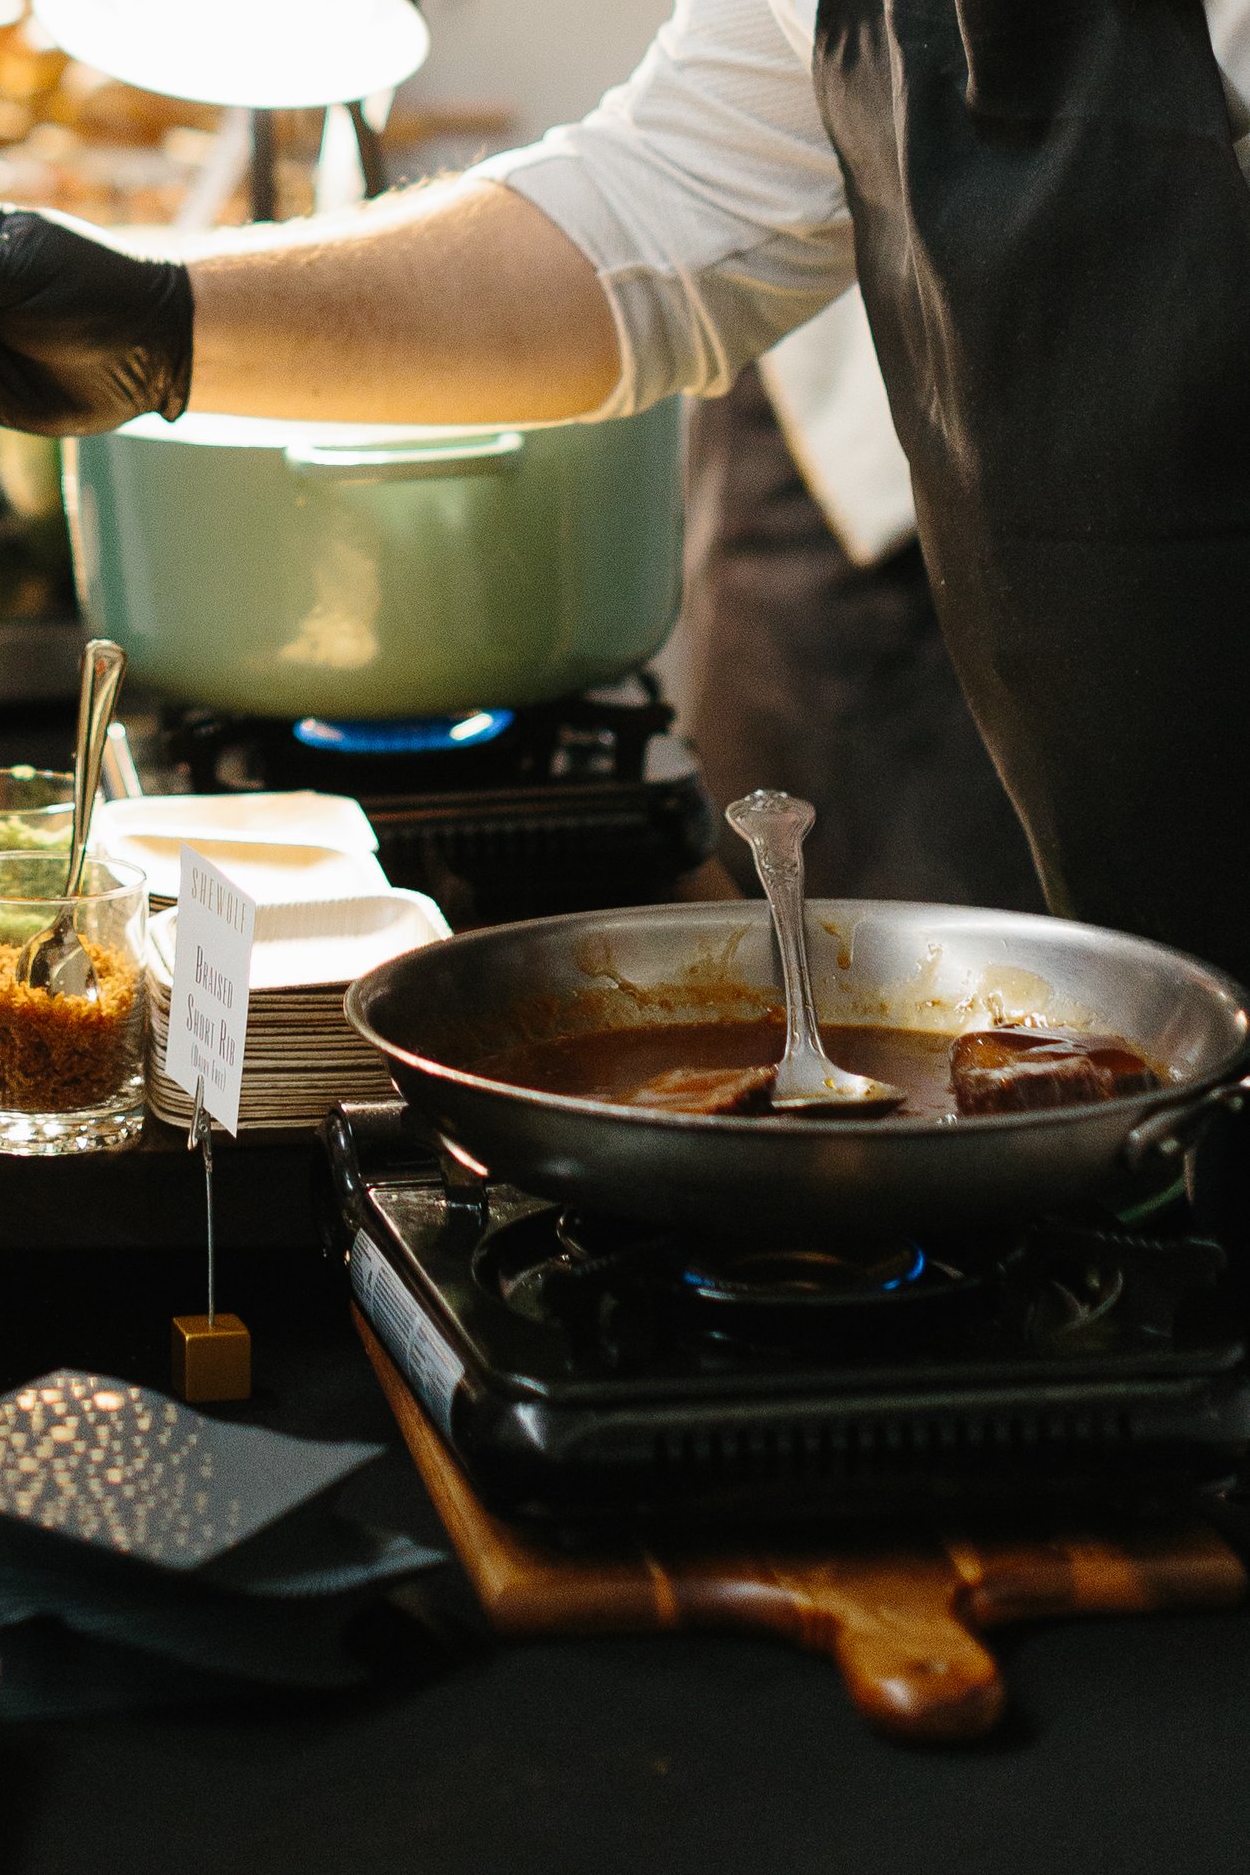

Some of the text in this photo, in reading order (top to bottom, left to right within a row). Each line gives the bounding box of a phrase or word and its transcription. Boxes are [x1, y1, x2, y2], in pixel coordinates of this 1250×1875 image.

[191, 867, 247, 934] SHEWOLF
[195, 945, 233, 1009] BRAISED
[186, 993, 236, 1067] SHORT RIB
